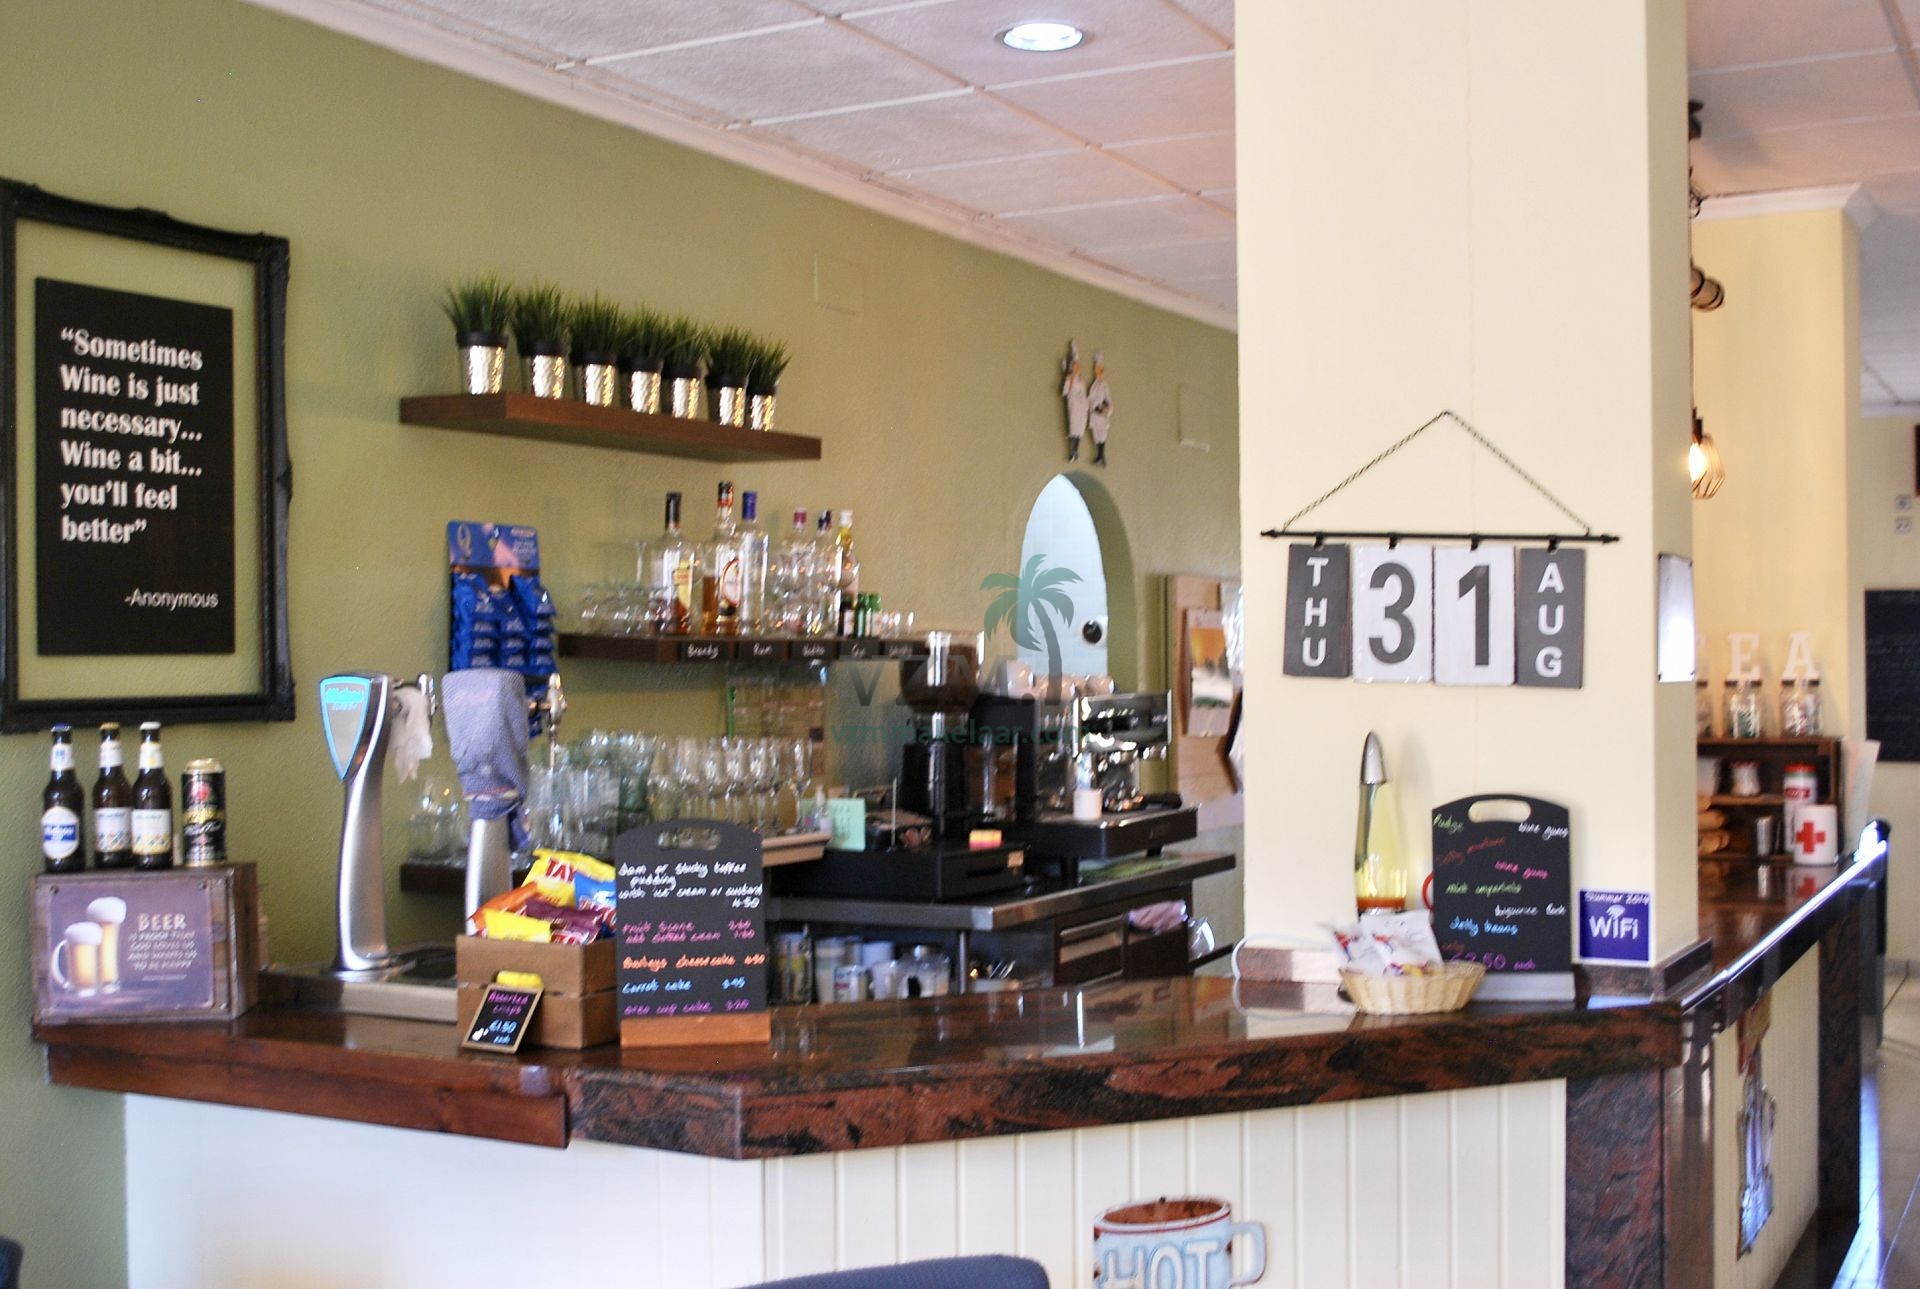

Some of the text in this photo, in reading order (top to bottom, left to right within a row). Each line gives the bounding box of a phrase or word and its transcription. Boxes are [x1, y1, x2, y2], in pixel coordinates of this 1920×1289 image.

[61, 327, 203, 371] “Sometimes
[60, 364, 200, 407] Wine is just
[61, 407, 203, 445] necessary...
[61, 439, 203, 477] Wine a bit...
[61, 480, 178, 511] you’ll feel
[61, 514, 148, 544] better”
[124, 588, 219, 611] -Anonymous
[1302, 557, 1328, 667] THU
[1535, 562, 1564, 677] AUG
[138, 912, 188, 931] BEER
